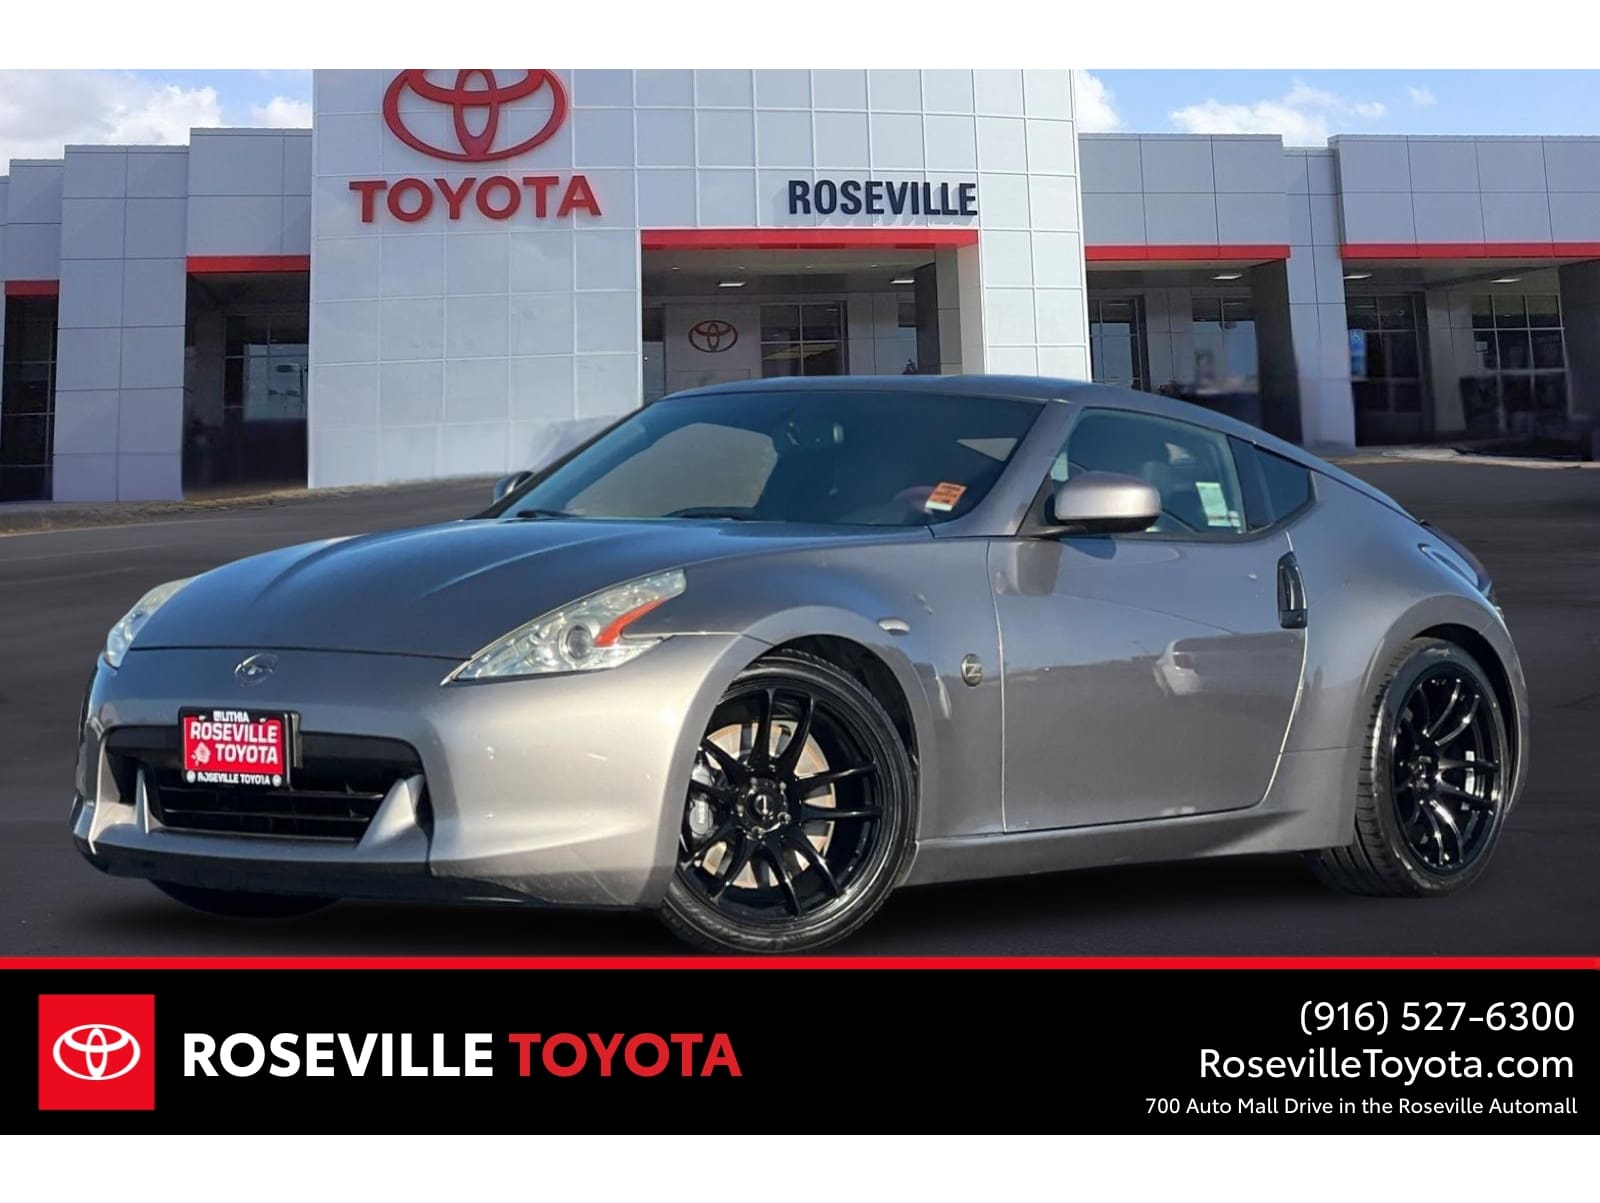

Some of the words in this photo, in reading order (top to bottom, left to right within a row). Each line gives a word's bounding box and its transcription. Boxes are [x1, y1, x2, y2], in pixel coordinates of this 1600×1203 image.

[349, 175, 602, 223] TOYOTA
[788, 179, 978, 217] ROSEVILLE
[190, 722, 279, 743] ROSEVILLE
[215, 744, 279, 764] TOYOTA
[241, 774, 271, 785] TOYOTA
